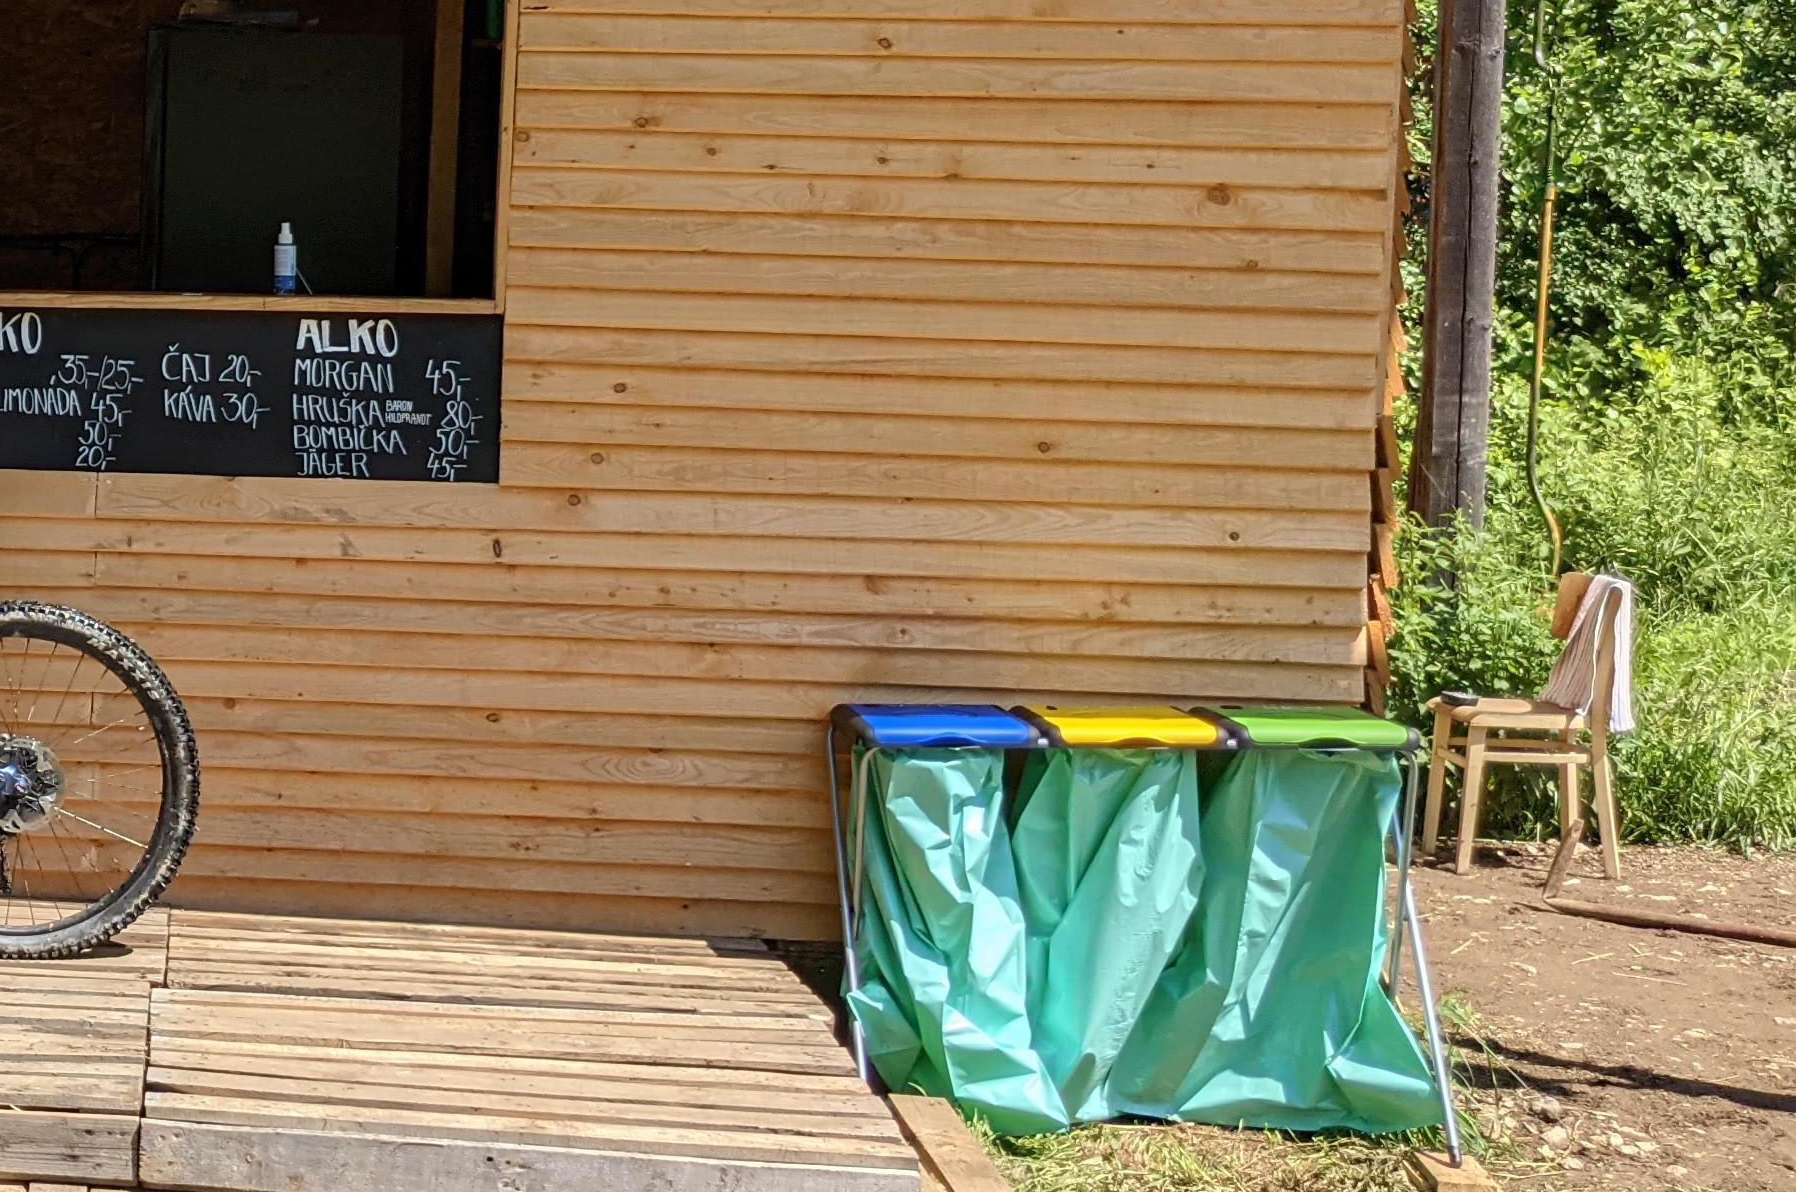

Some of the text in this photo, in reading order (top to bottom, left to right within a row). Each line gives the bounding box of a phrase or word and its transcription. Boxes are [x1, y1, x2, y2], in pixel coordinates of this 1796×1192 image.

[296, 319, 399, 358] ALKO
[161, 342, 210, 383] ČAJ
[294, 358, 394, 394] MORGAN
[164, 384, 217, 423] KÁVA
[292, 391, 386, 428] HRUŠKA
[293, 423, 408, 456] BOMBIČKA
[293, 448, 370, 478] JÄGER
